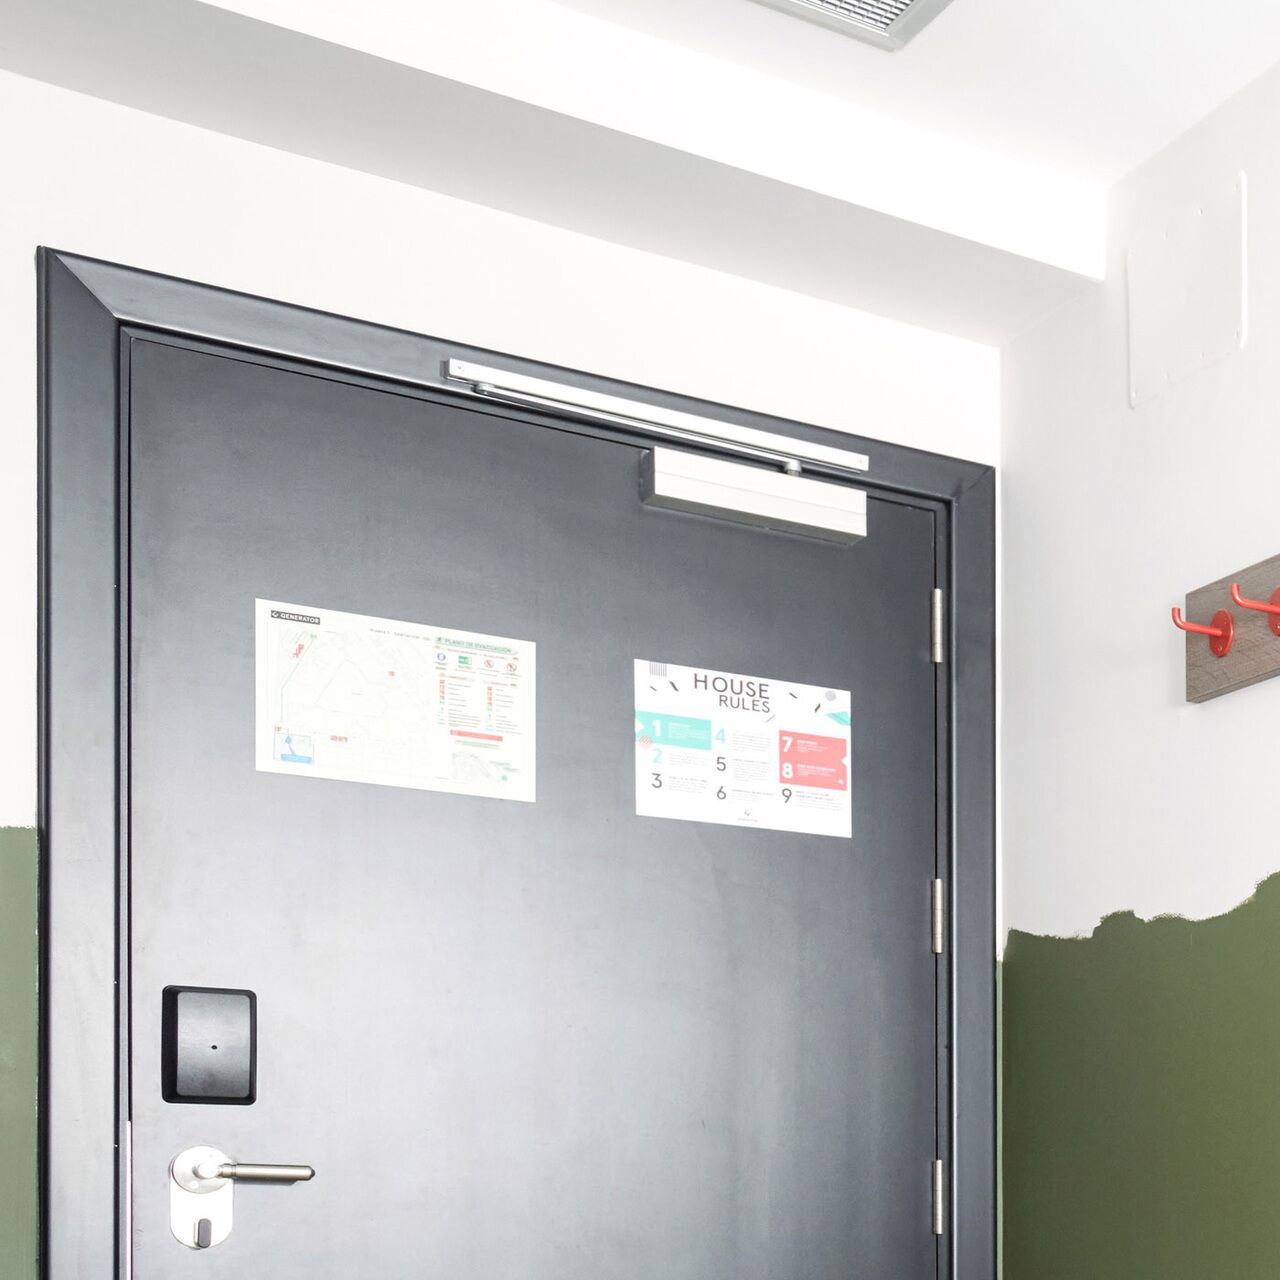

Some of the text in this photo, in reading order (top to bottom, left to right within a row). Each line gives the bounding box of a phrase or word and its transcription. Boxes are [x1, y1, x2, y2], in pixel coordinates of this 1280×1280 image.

[280, 613, 319, 624] GENERATOR
[694, 673, 770, 700] HOUSE
[719, 694, 771, 713] RULES
[652, 719, 662, 737] 1
[715, 728, 726, 744] 4
[782, 736, 793, 752] 7
[652, 748, 662, 764] 2
[716, 756, 727, 772] 5
[782, 762, 793, 779] 8
[651, 773, 662, 789] 3
[716, 786, 727, 800] 6
[781, 788, 793, 803] 9
